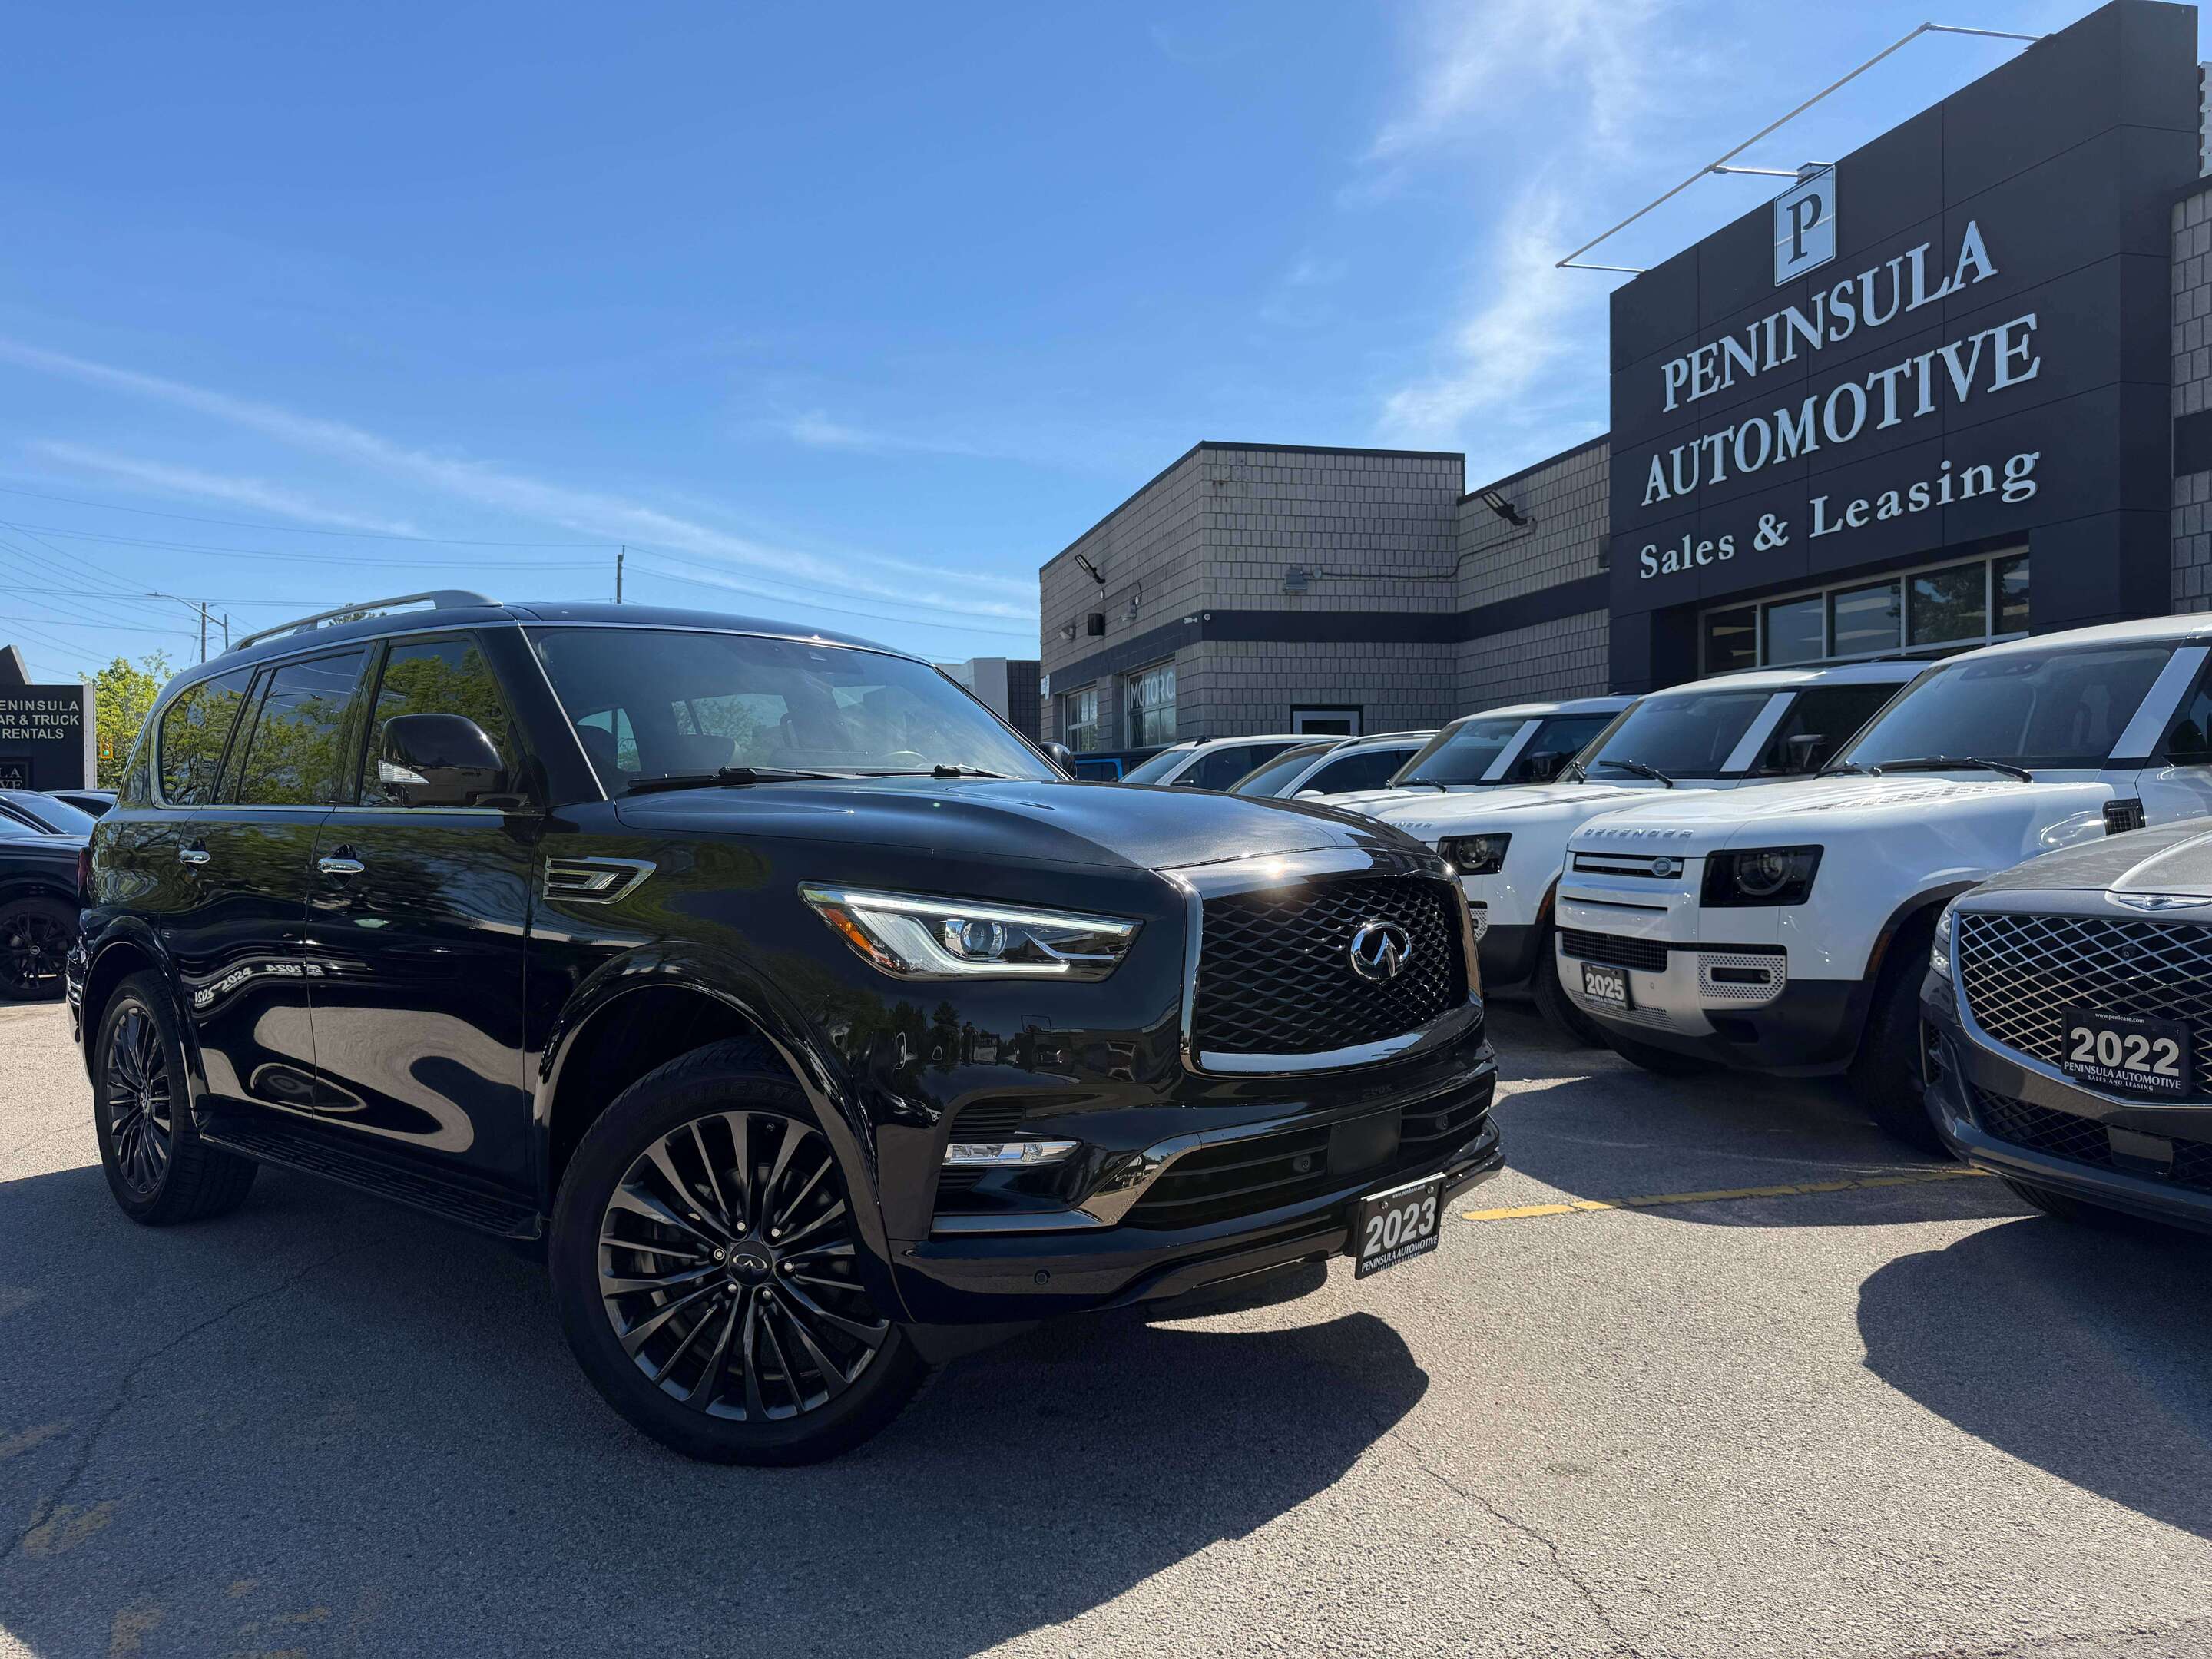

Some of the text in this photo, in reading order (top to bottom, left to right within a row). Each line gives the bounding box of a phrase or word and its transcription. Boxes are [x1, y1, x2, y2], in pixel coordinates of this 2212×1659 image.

[1786, 194, 1822, 265] P
[1661, 220, 1999, 413] PENINSULA
[1641, 313, 2041, 507] AUTOMOTIVE
[1641, 452, 2041, 579] Sales & Leasing
[2, 728, 65, 739] RENTALS
[19, 714, 28, 725] &
[32, 714, 79, 726] TRUCK
[1584, 829, 1694, 838] DEFENDER
[1585, 972, 1625, 1000] 2025
[2070, 1027, 2179, 1076] 2022
[2064, 1061, 2181, 1089] PENINSULA AUTOMOTIVE
[2125, 1081, 2154, 1091] LEASING
[1363, 1197, 1437, 1257] 2023
[1361, 1235, 1439, 1273] PENINSULA AUTOMOTIVE
